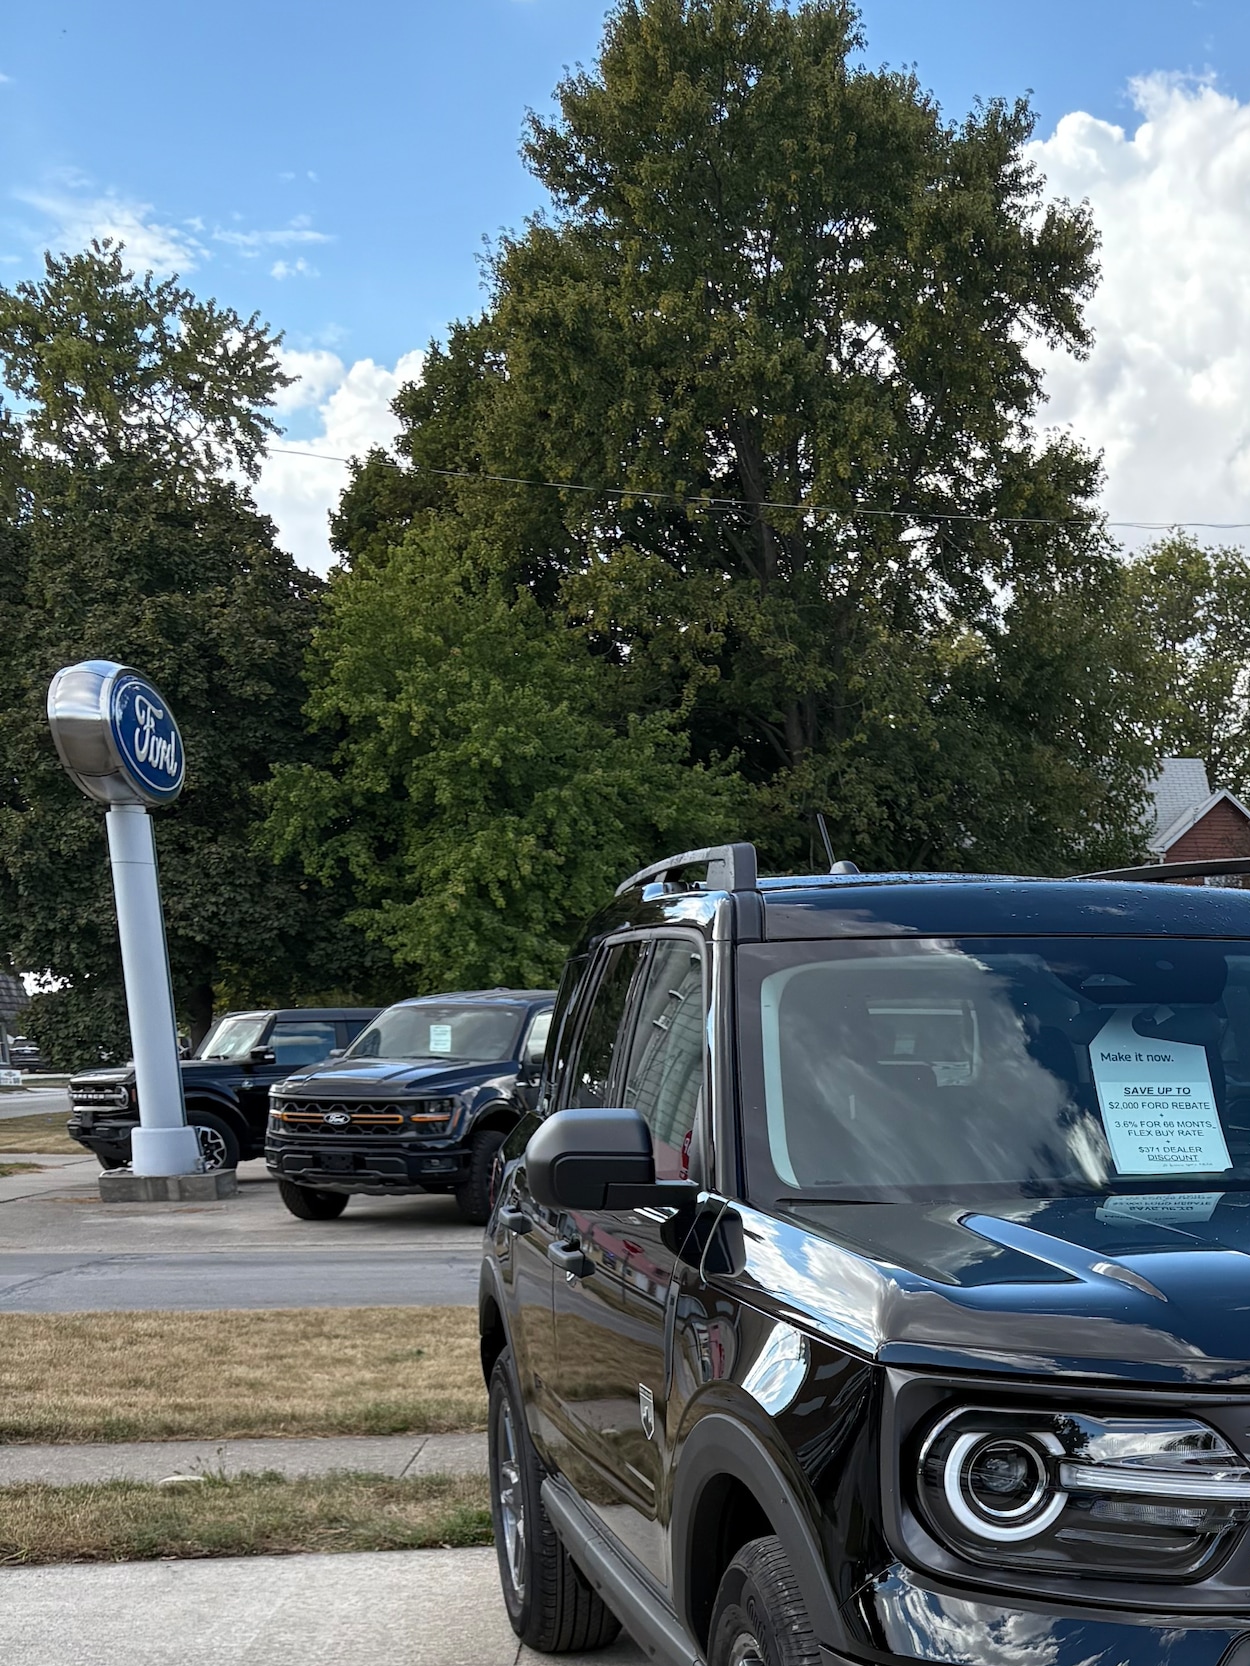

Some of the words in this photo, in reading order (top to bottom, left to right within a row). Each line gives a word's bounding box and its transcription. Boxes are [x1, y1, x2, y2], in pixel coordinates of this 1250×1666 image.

[134, 694, 178, 777] Ford
[1100, 1052, 1132, 1062] Make
[1135, 1052, 1143, 1062] it
[1146, 1053, 1175, 1062] now.
[1123, 1086, 1154, 1095] SAVE
[1157, 1086, 1173, 1095] UP
[1177, 1086, 1191, 1095] TO
[1108, 1101, 1139, 1110] $2,000
[1141, 1101, 1169, 1110] FORD
[1171, 1101, 1211, 1110] REBATE
[1140, 1120, 1161, 1128] FOR
[1127, 1129, 1154, 1137] FLEX
[1155, 1129, 1175, 1137] BUY
[1177, 1129, 1205, 1137] RATE
